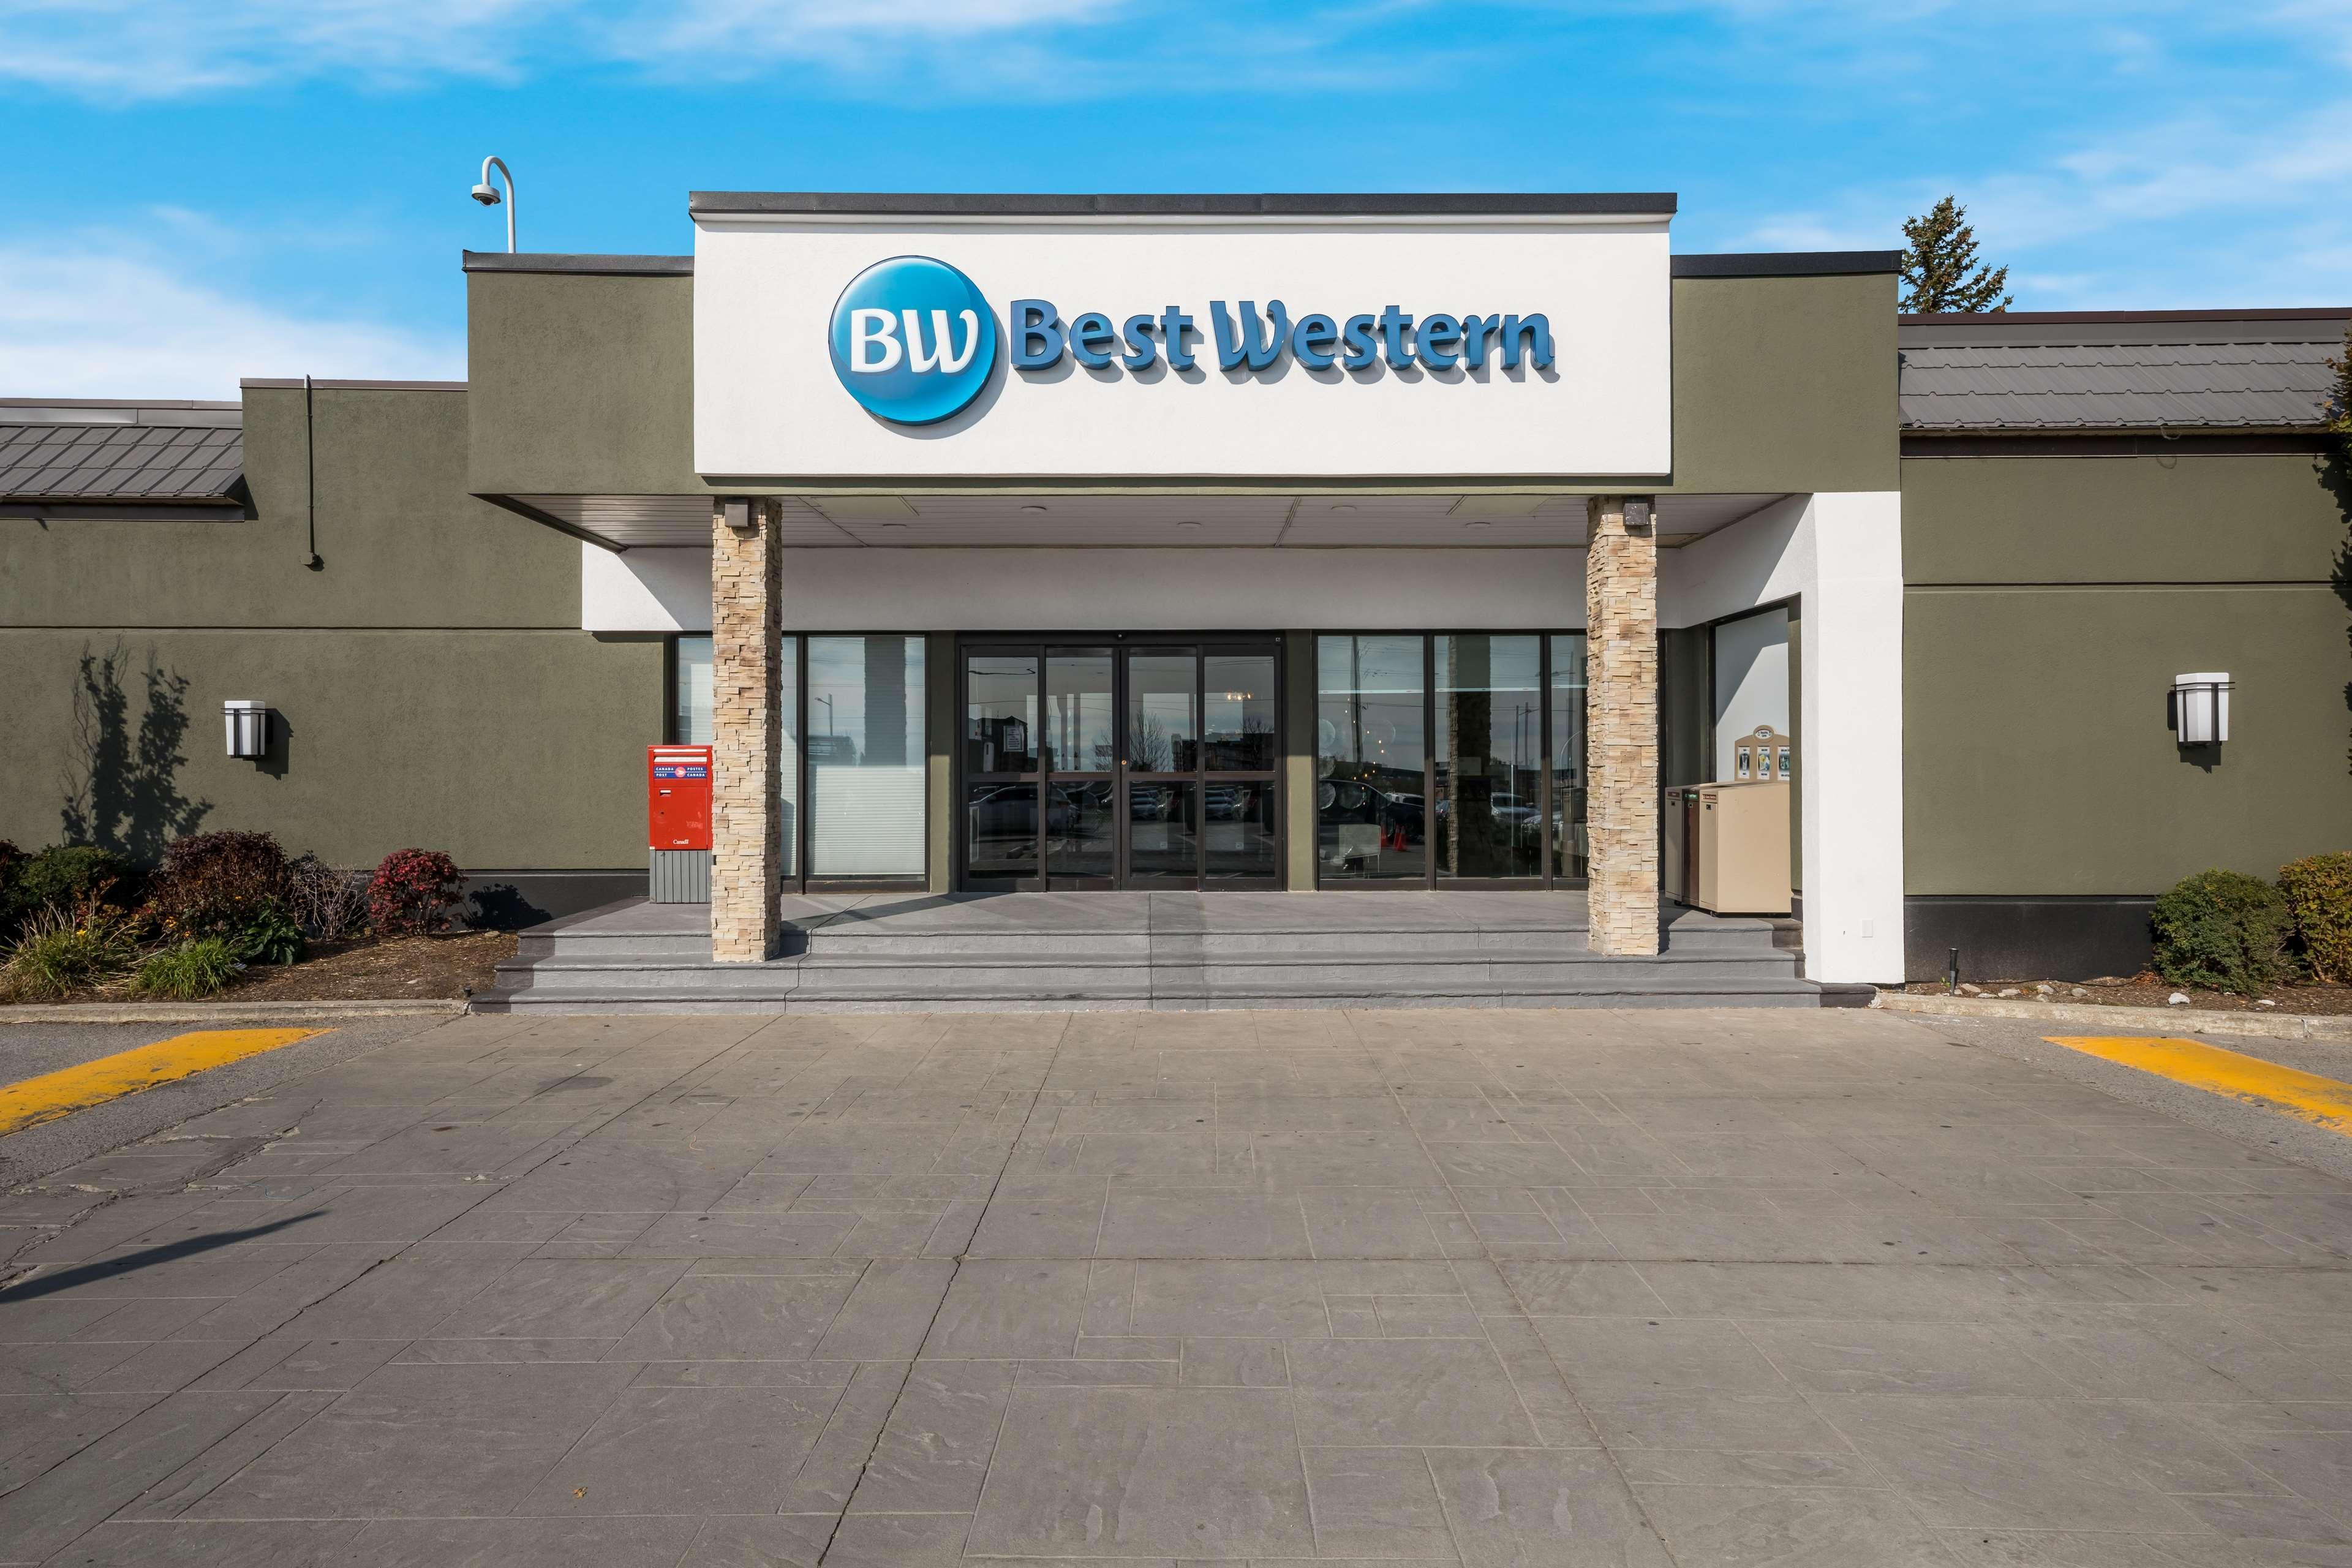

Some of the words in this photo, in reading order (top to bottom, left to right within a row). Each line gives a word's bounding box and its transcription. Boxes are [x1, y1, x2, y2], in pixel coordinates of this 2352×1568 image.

[851, 308, 979, 374] BW
[1010, 299, 1196, 369] Best
[1210, 300, 1556, 370] Western
